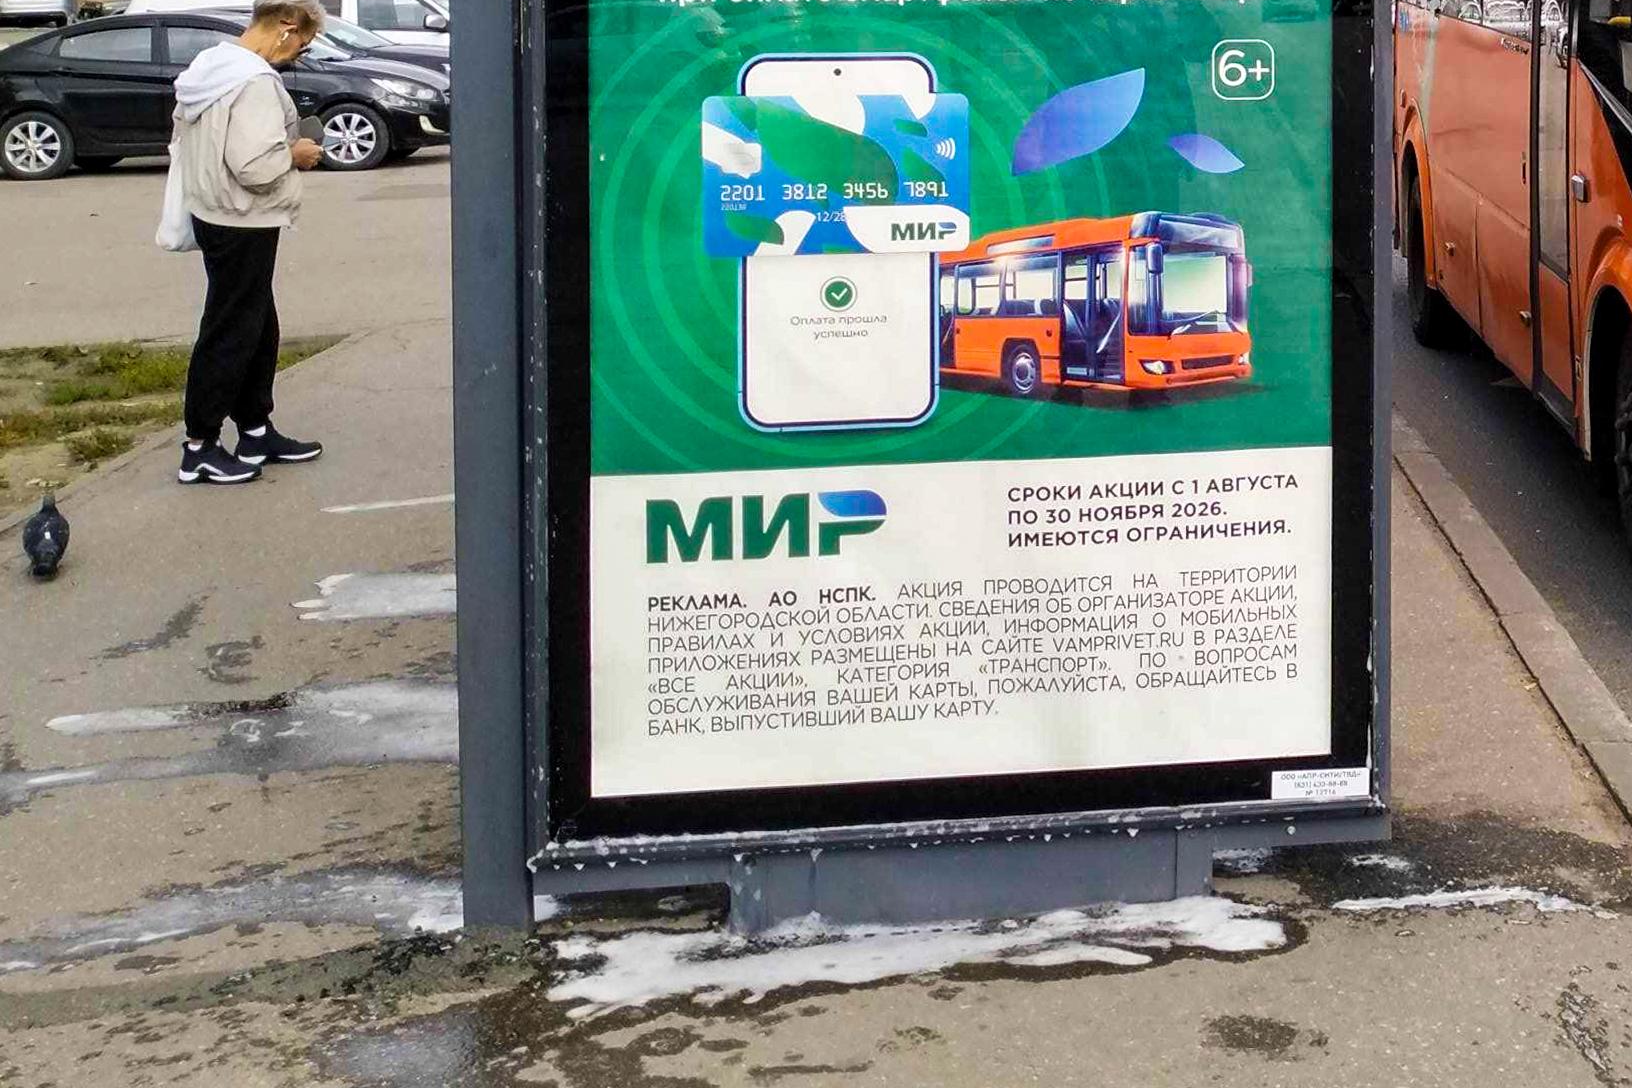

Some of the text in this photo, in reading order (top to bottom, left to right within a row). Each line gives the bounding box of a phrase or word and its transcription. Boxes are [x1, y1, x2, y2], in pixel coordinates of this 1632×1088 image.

[1219, 49, 1270, 87] 6+
[721, 181, 949, 201] 2201 3812 3456 7891
[891, 222, 957, 241] МИР
[790, 315, 887, 326] Оплата прошла
[814, 329, 869, 340] успешно
[1008, 474, 1298, 502] СРОКИ АКЦИИ С 1 АВГУСТА
[646, 490, 887, 564] МИР
[1008, 502, 1227, 525] ПО 30 НОЯБРЯ 2026.
[1008, 519, 1291, 547] ИМЕЮТСЯ ОГРАНИЧЕНИЯ.
[648, 564, 1297, 612] РЕКЛАМА. АО НСПК. АКЦИЯ ПРОВОДИТСЯ НА ТЕРРИТОРИИ
[648, 584, 1297, 632] НИЖЕГОРОДСКОЙ ОБЛАСТИ. СВЕДЕНИЯ ОБ ОРГАНИЗАТОРЕ АКЦИИ,
[648, 632, 755, 653] ПРАВИЛАХ
[771, 632, 783, 647] И
[798, 624, 905, 645] УСЛОВИЯХ
[1004, 613, 1138, 633] ИНФОРМАЦИЯ
[1153, 612, 1166, 628] О
[1181, 604, 1297, 626] МОБИЛЬНЫХ
[648, 623, 1297, 674] ПРИЛОЖЕНИЯХ РАЗМЕЩЕНЫ НА САЙТЕ VAMPRIVET.RU В РАЗДЕЛЕ
[648, 676, 696, 694] «ВСЕ
[837, 662, 950, 684] КАТЕГОРИЯ
[979, 656, 1111, 675] «ТРАНСПОРТ».
[1140, 652, 1166, 668] ПО
[1194, 644, 1297, 666] ВОПРОСАМ
[648, 663, 1298, 715] ОБСЛУЖИВАНИЯ ВАШЕЙ КАРТЫ, ПОЖАЛУЙСТА, ОБРАЩАЙТЕСЬ В
[648, 700, 999, 736] БАНК, ВЫПУСТИВШИЙ ВАШУ КАРТУ.
